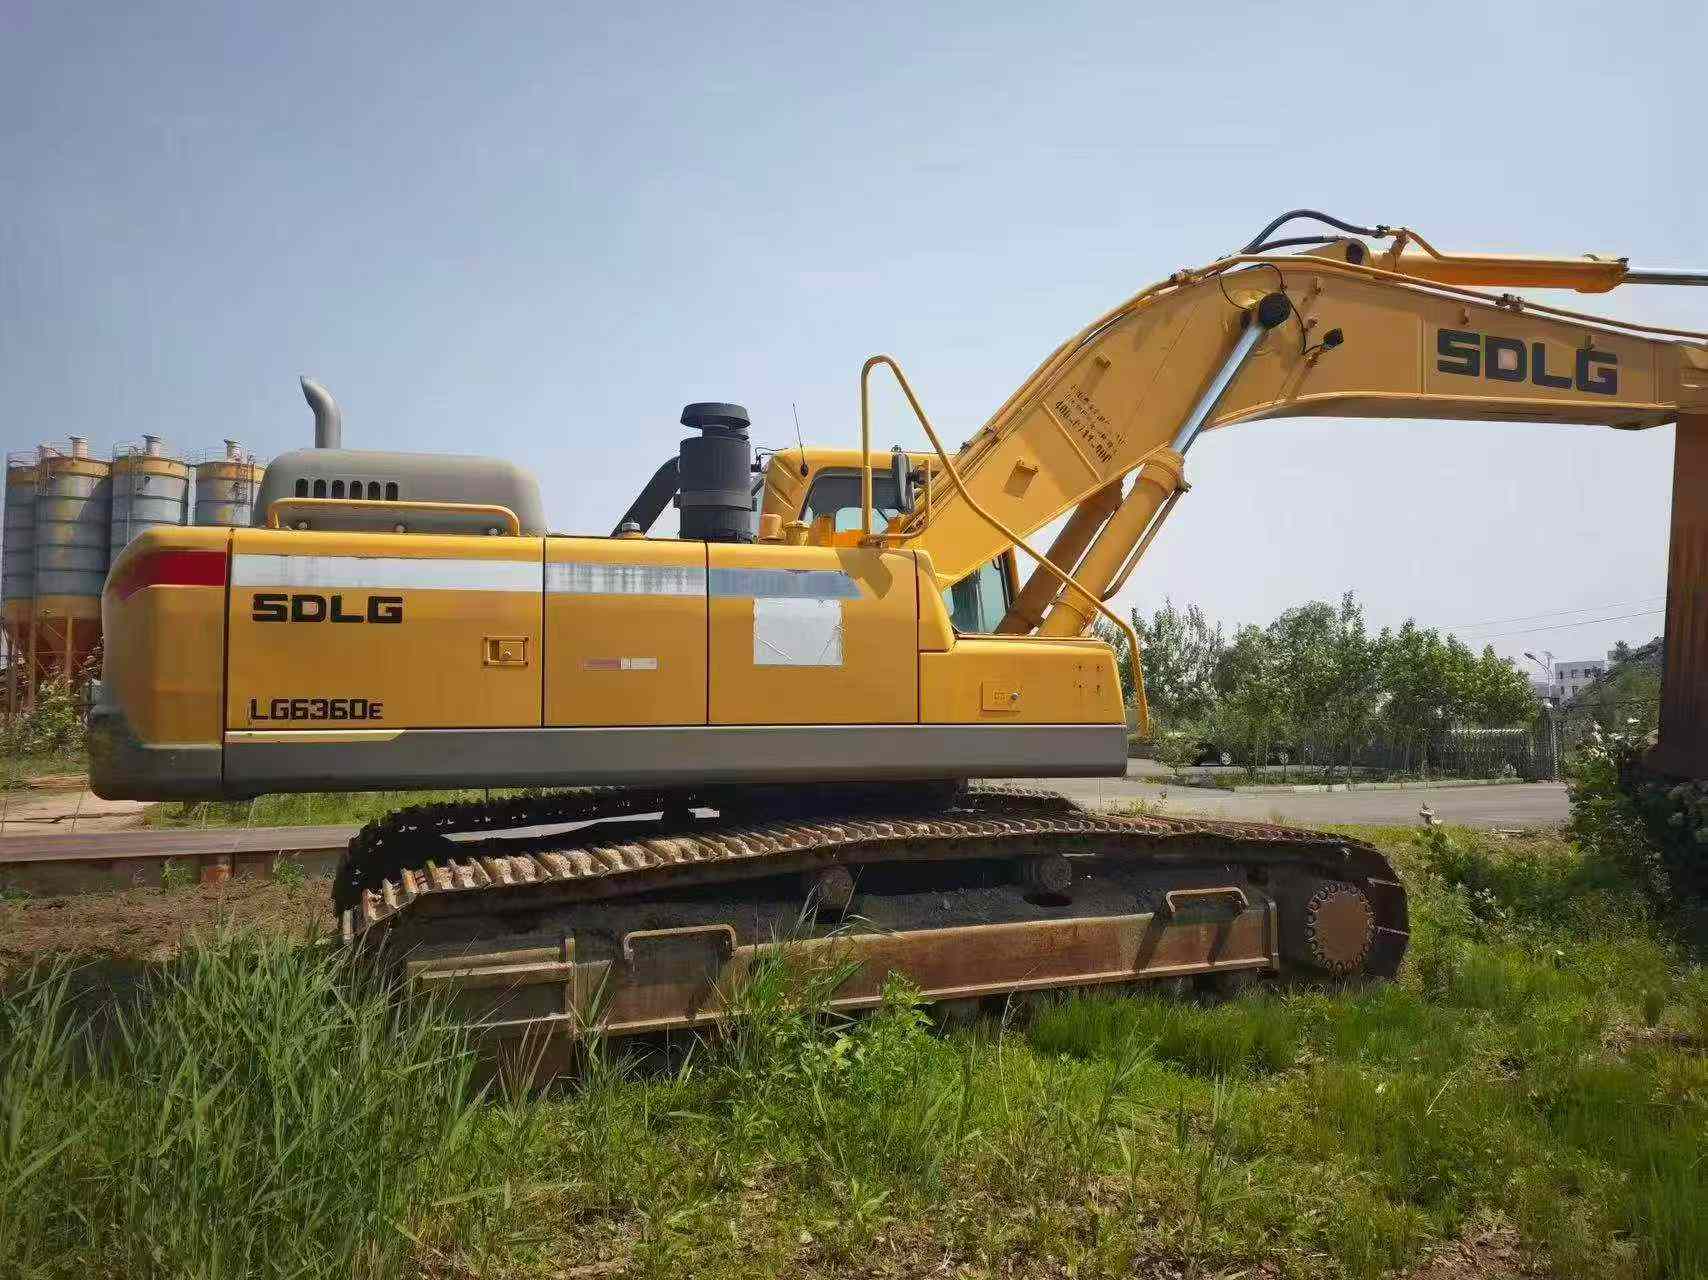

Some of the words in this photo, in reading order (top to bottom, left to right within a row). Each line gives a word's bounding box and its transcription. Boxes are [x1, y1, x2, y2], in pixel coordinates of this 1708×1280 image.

[1437, 328, 1618, 396] SDLG
[252, 593, 404, 624] SDLG
[250, 698, 384, 720] LG6360E
